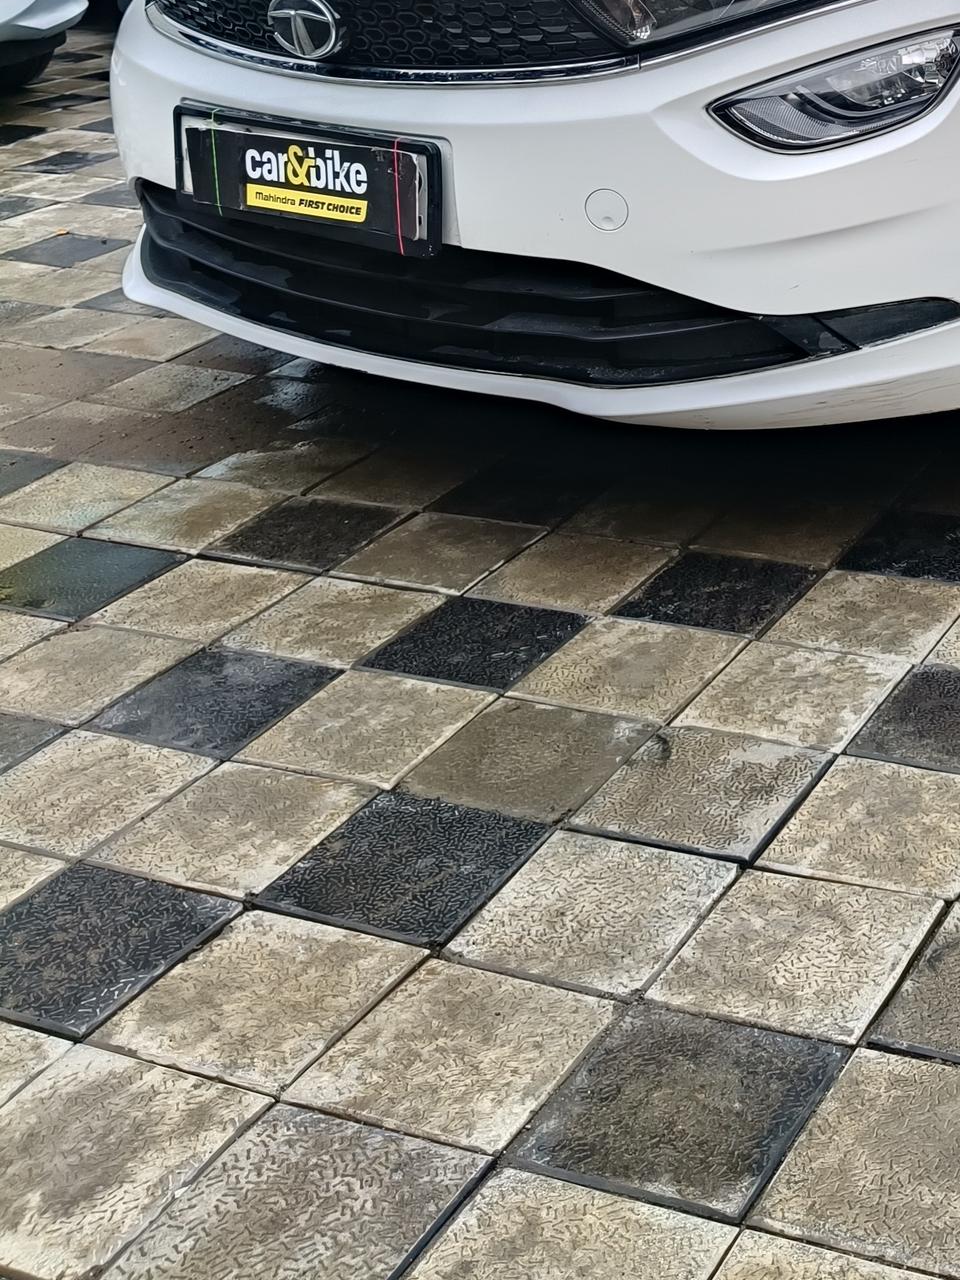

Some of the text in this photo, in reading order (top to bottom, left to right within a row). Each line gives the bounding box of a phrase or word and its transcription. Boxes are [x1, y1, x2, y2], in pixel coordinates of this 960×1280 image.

[245, 144, 368, 195] car&bike
[298, 198, 326, 210] FIRST
[326, 203, 362, 216] CHOICE
